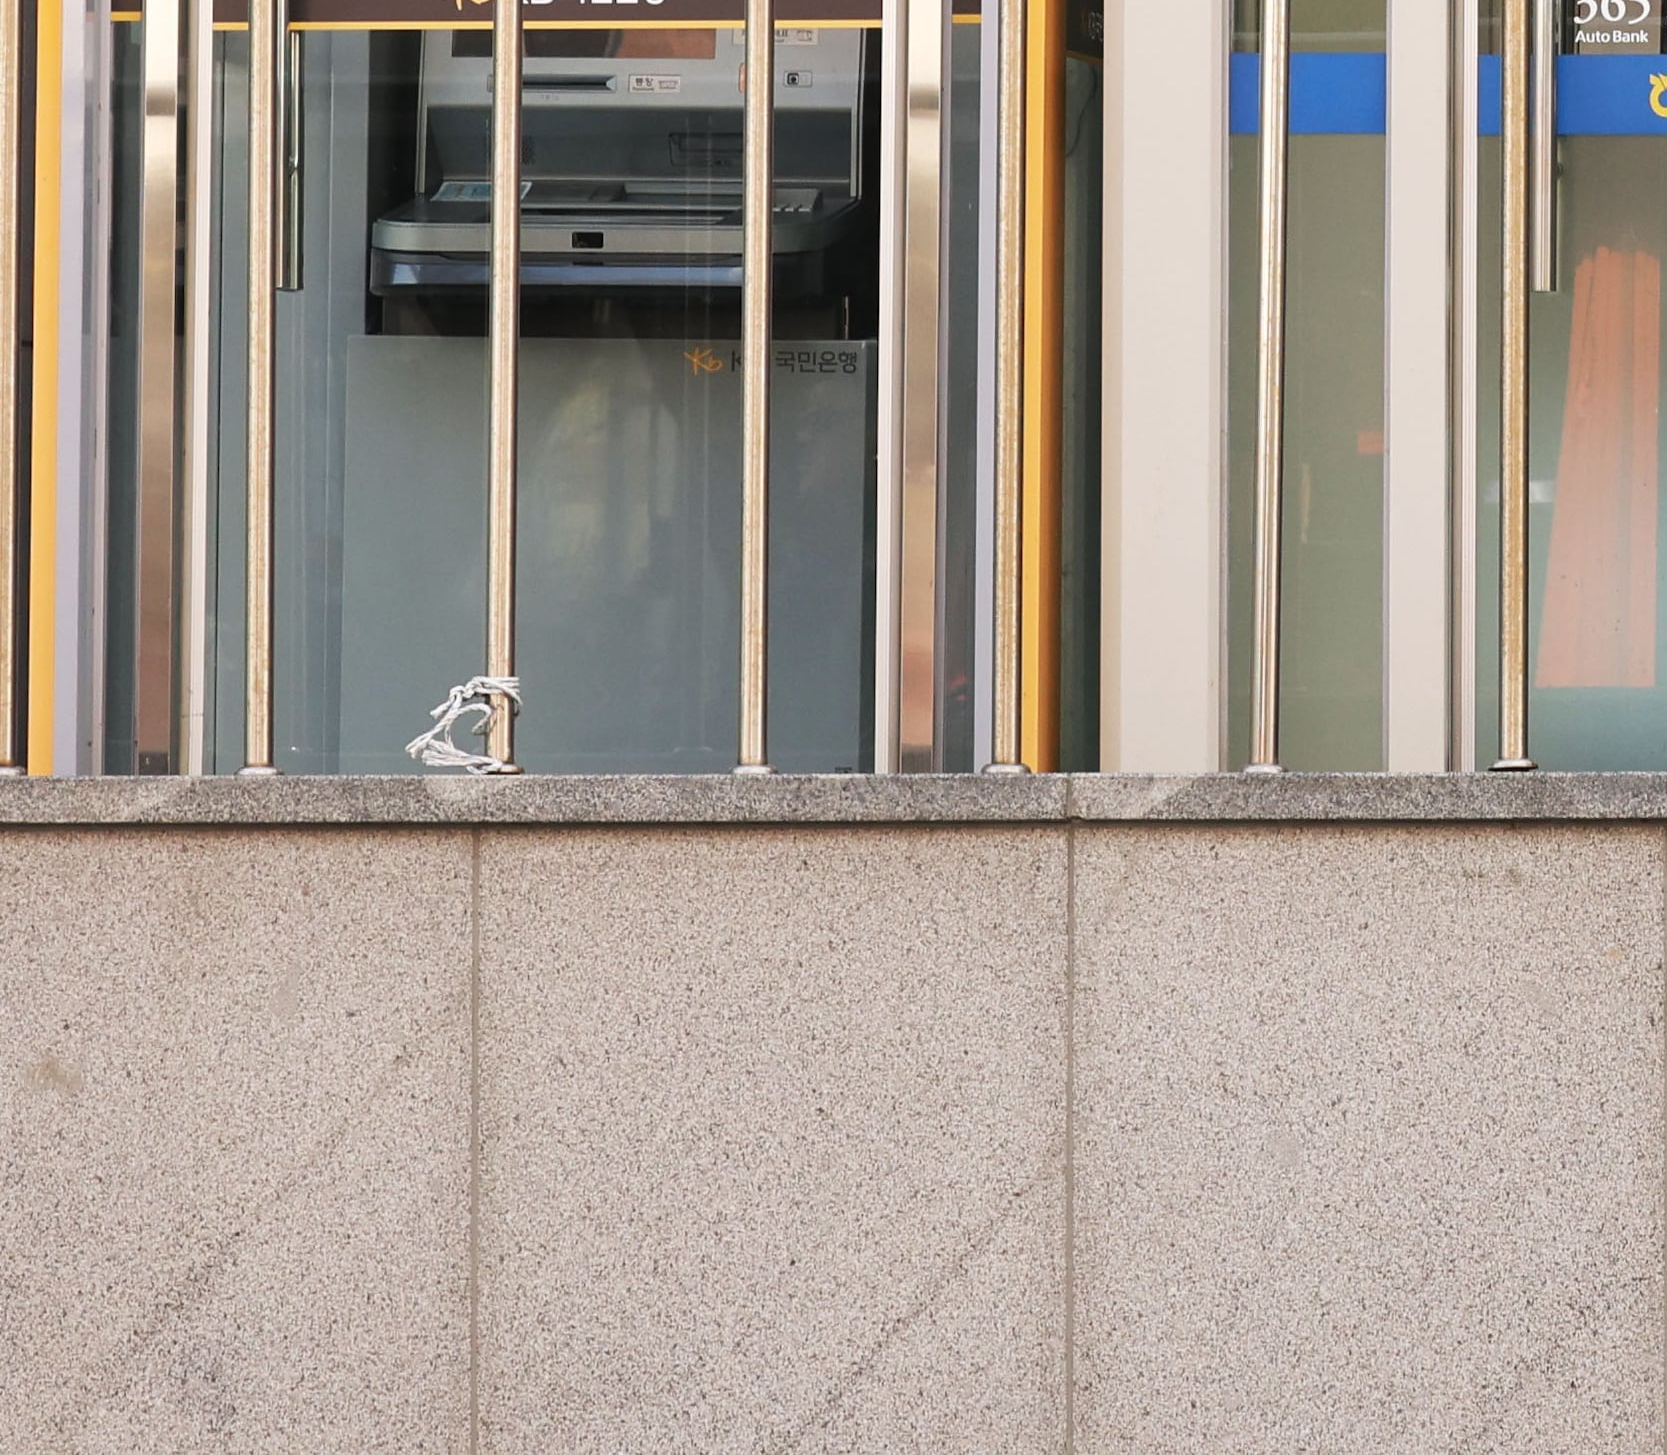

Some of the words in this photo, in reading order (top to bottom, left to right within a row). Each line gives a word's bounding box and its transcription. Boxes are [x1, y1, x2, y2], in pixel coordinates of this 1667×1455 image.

[1574, 30, 1609, 44] Auto
[1613, 30, 1649, 44] Bank
[776, 351, 857, 374] 국민은행
